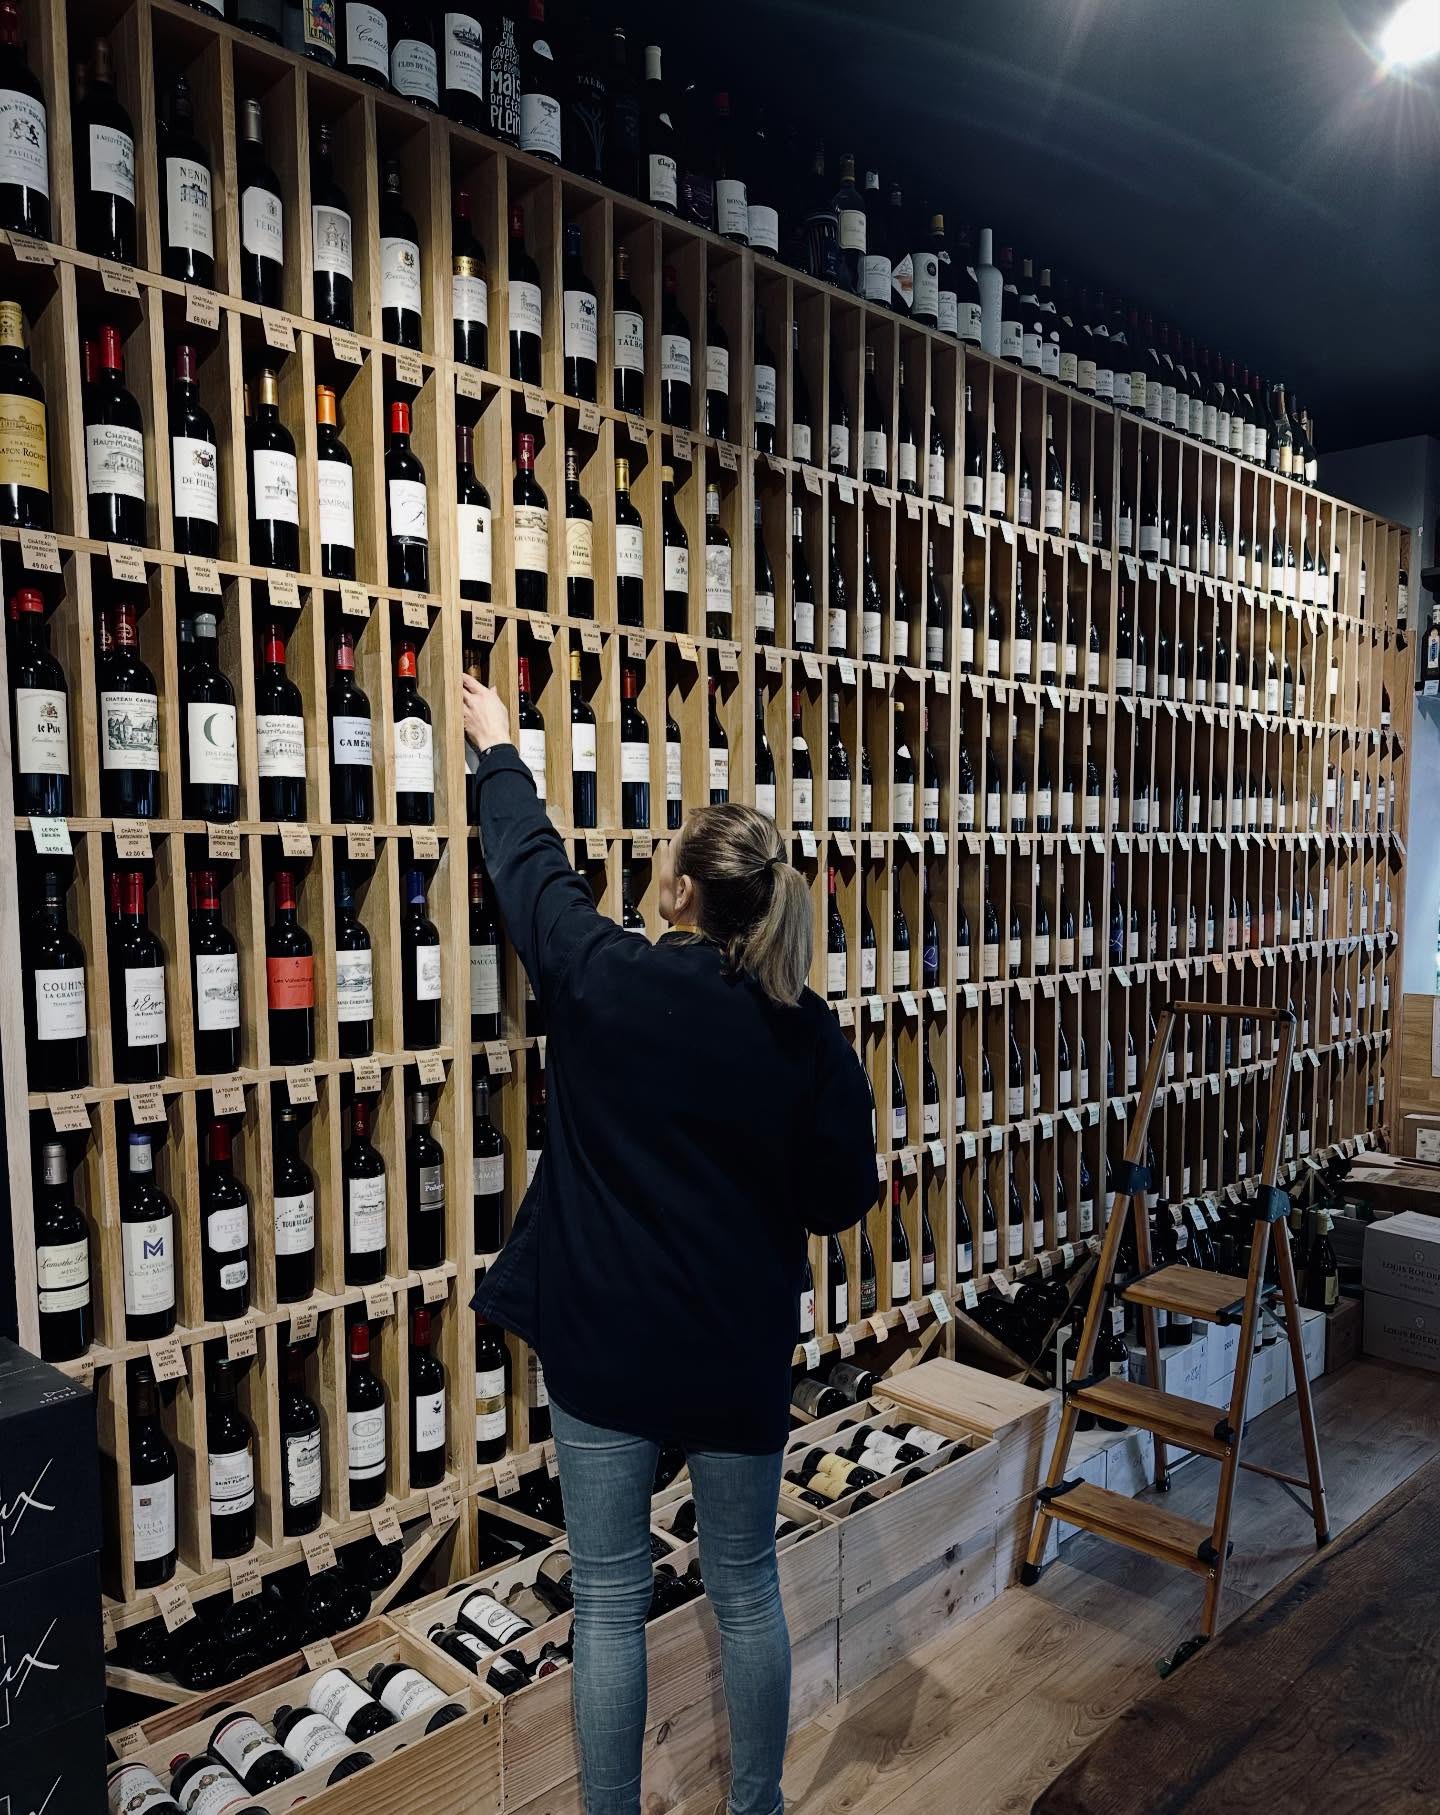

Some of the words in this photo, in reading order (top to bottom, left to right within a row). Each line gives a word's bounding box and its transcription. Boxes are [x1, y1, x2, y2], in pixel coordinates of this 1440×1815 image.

[180, 167, 208, 186] NENIN
[1382, 1261, 1407, 1274] LOUIS
[1383, 1325, 1408, 1338] LOUIS
